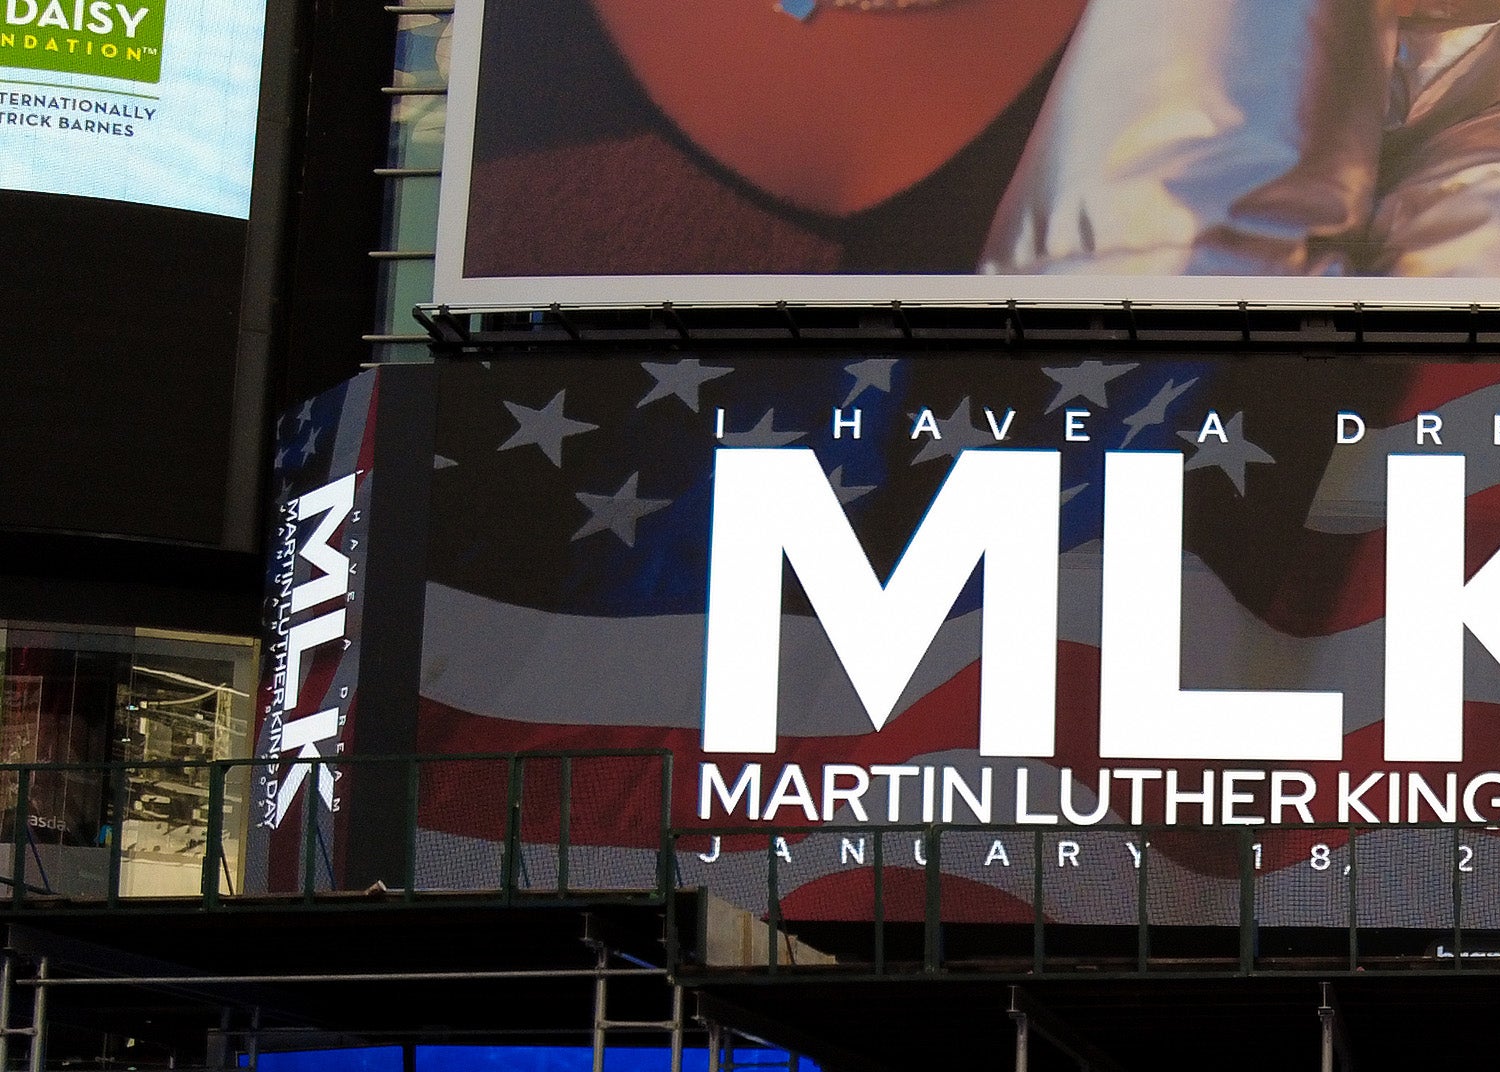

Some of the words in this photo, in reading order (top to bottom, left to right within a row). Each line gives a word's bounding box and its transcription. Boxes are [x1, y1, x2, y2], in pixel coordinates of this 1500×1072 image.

[6, 0, 149, 38] DAISY
[58, 116, 134, 137] BARNES
[714, 408, 726, 440] I
[832, 408, 1091, 442] HAVE
[1197, 412, 1229, 443] A
[280, 498, 299, 597] MARTIN
[346, 510, 359, 602] HAVE
[273, 602, 291, 705] LUTHER
[275, 473, 356, 829] MLK
[342, 638, 352, 650] A
[330, 686, 348, 813] DREAM
[262, 780, 279, 829] DAY
[699, 763, 992, 823] MARTIN
[1015, 768, 1317, 826] LUTHER
[1251, 842, 1352, 875] 18,
